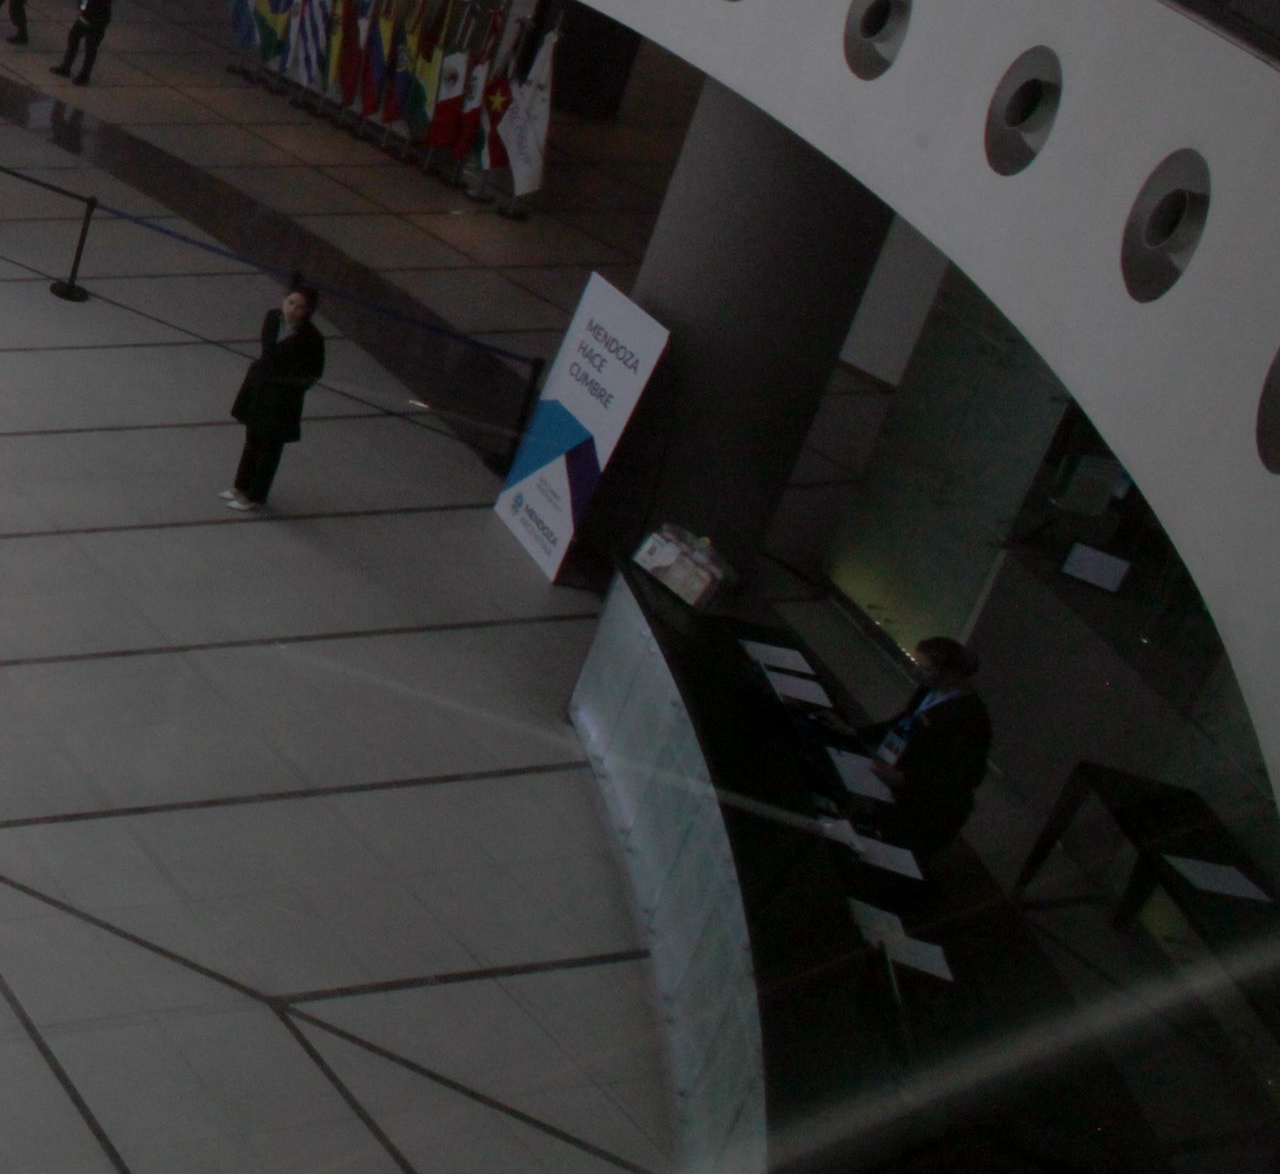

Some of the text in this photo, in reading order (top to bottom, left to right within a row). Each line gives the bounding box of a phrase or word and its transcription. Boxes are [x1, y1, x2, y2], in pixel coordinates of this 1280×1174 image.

[578, 340, 608, 373] HACE
[585, 318, 640, 374] MENDOZA
[569, 363, 614, 409] CUMBRE
[525, 504, 557, 546] MENDOZA
